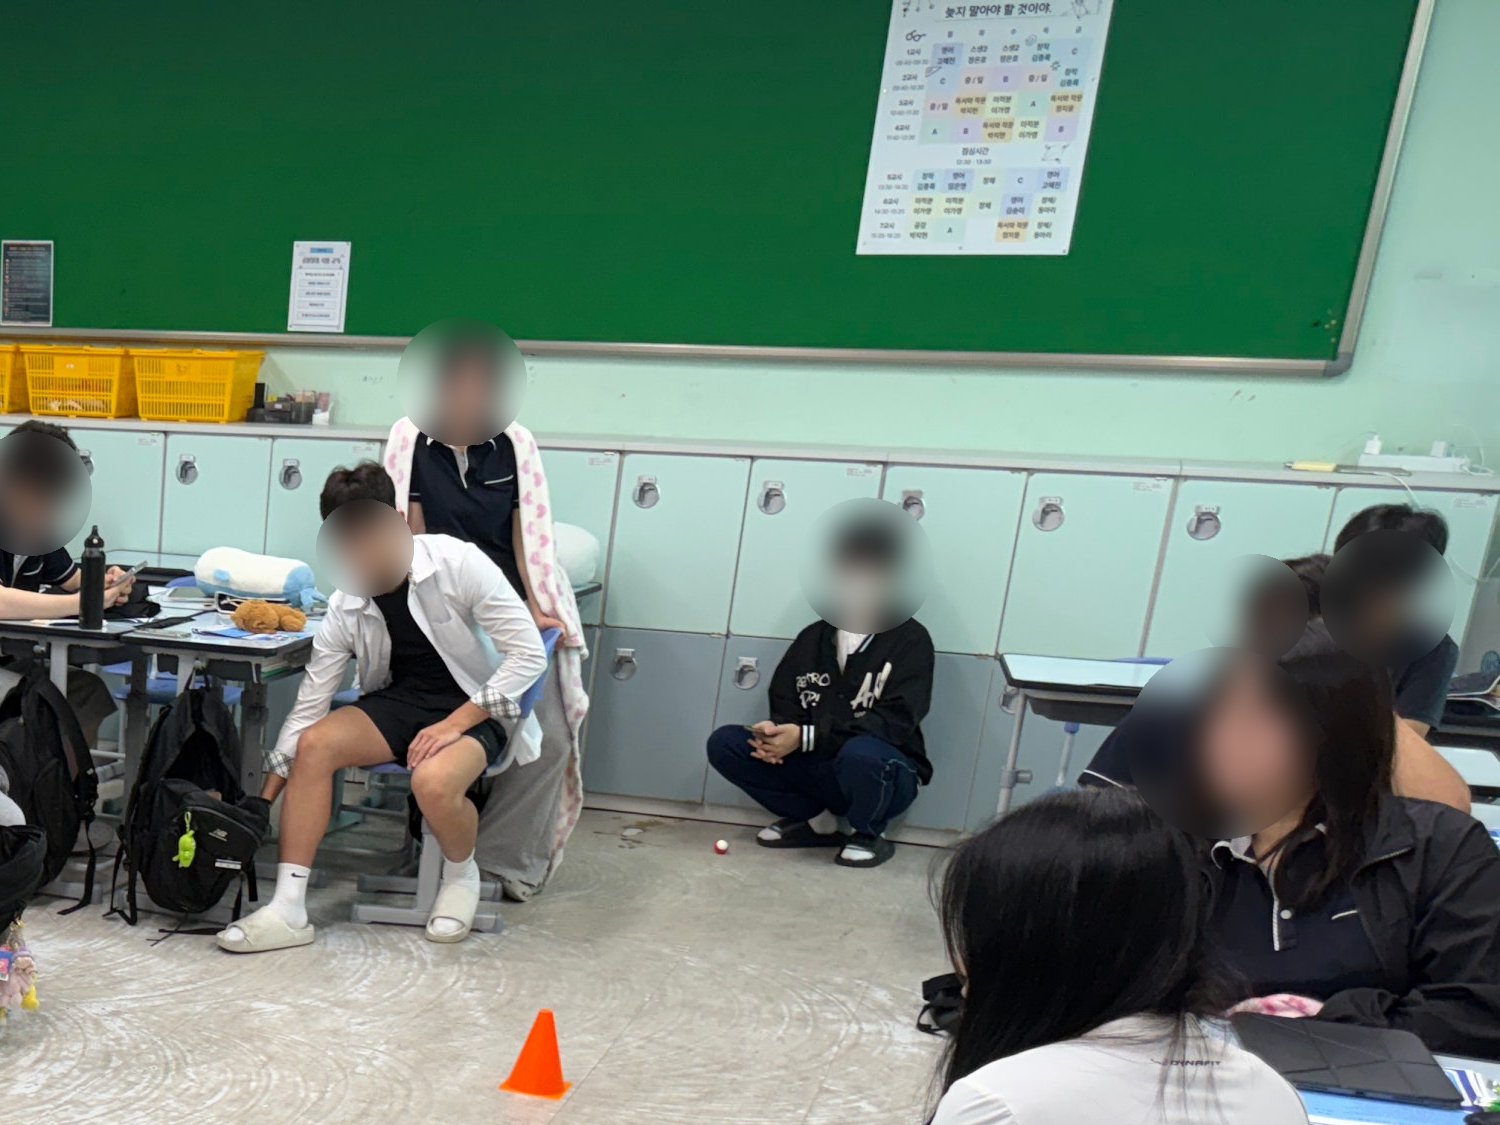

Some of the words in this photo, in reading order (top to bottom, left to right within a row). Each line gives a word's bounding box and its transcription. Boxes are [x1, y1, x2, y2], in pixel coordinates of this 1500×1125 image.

[945, 6, 966, 18] 늦지
[969, 5, 1001, 17] 말아야
[1004, 4, 1015, 16] 할
[1018, 2, 1052, 15] 것이야.
[1071, 47, 1078, 55] C
[940, 77, 946, 85] C
